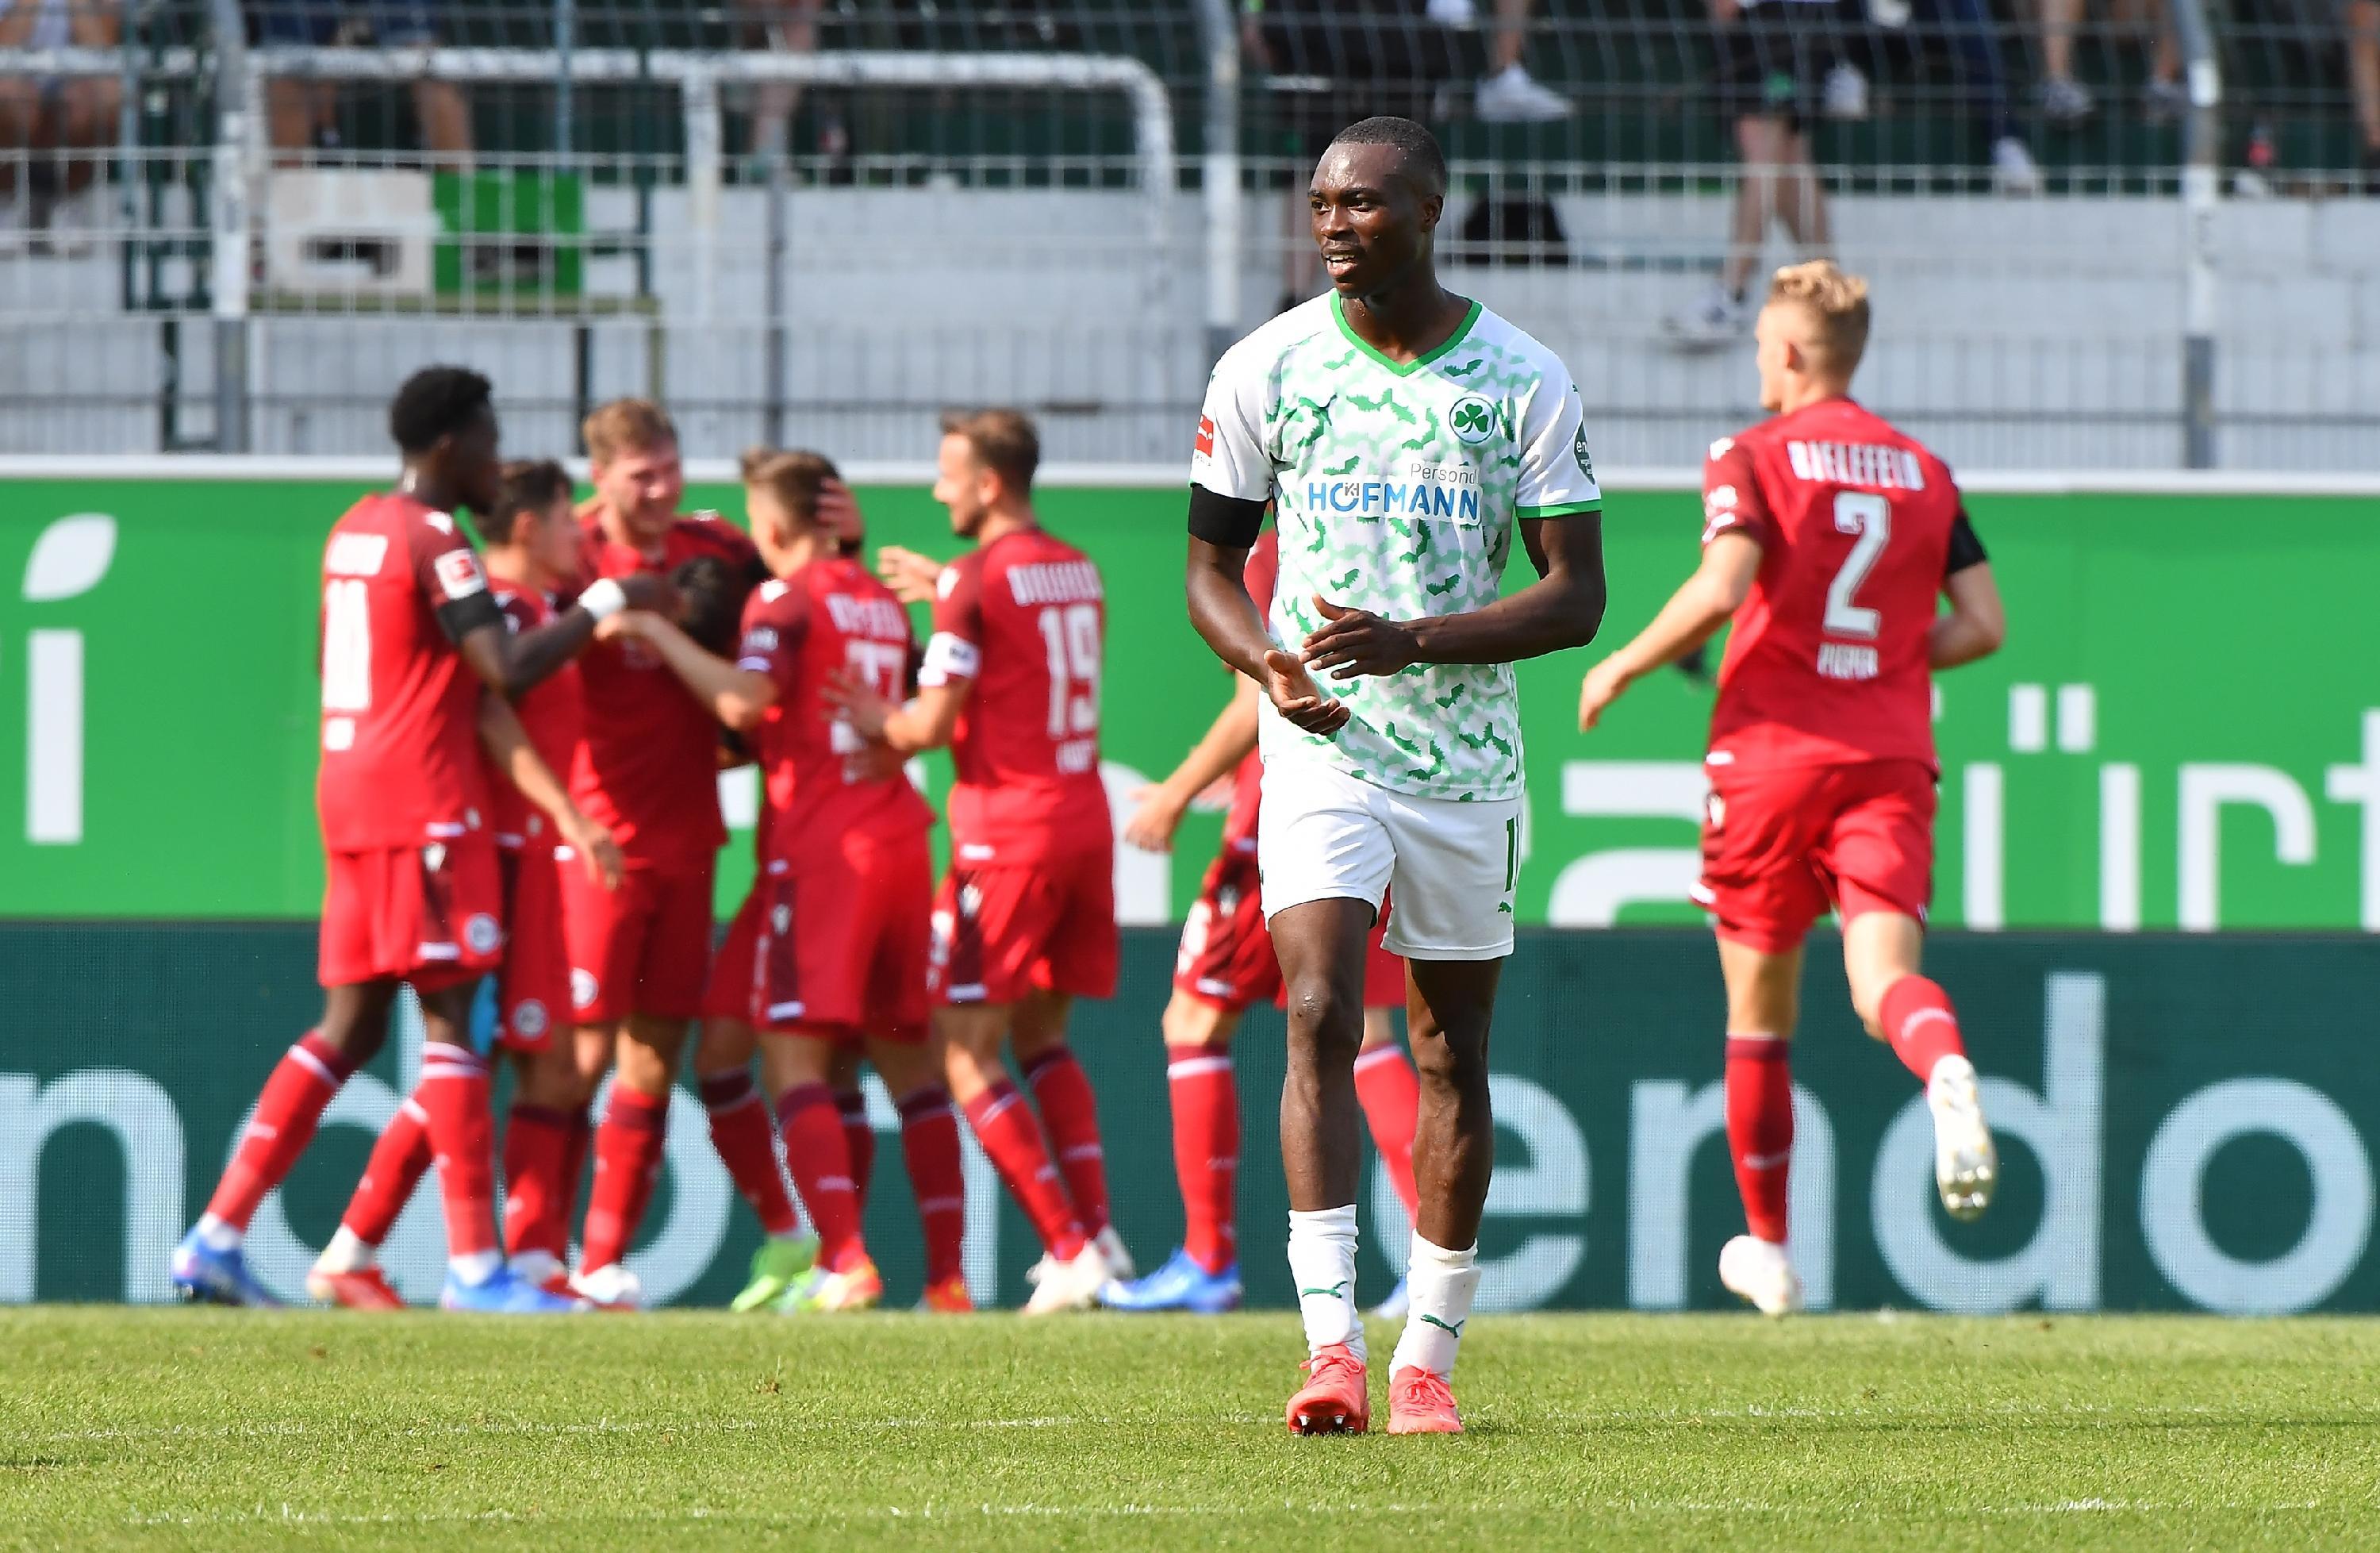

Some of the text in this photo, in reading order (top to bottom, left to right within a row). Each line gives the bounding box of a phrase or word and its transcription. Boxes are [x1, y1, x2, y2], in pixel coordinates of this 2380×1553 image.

[1308, 482, 1479, 521] HOFMANN
[1822, 490, 1891, 640] 2
[1038, 604, 1099, 740] 19
[1931, 682, 2380, 932] ürt
